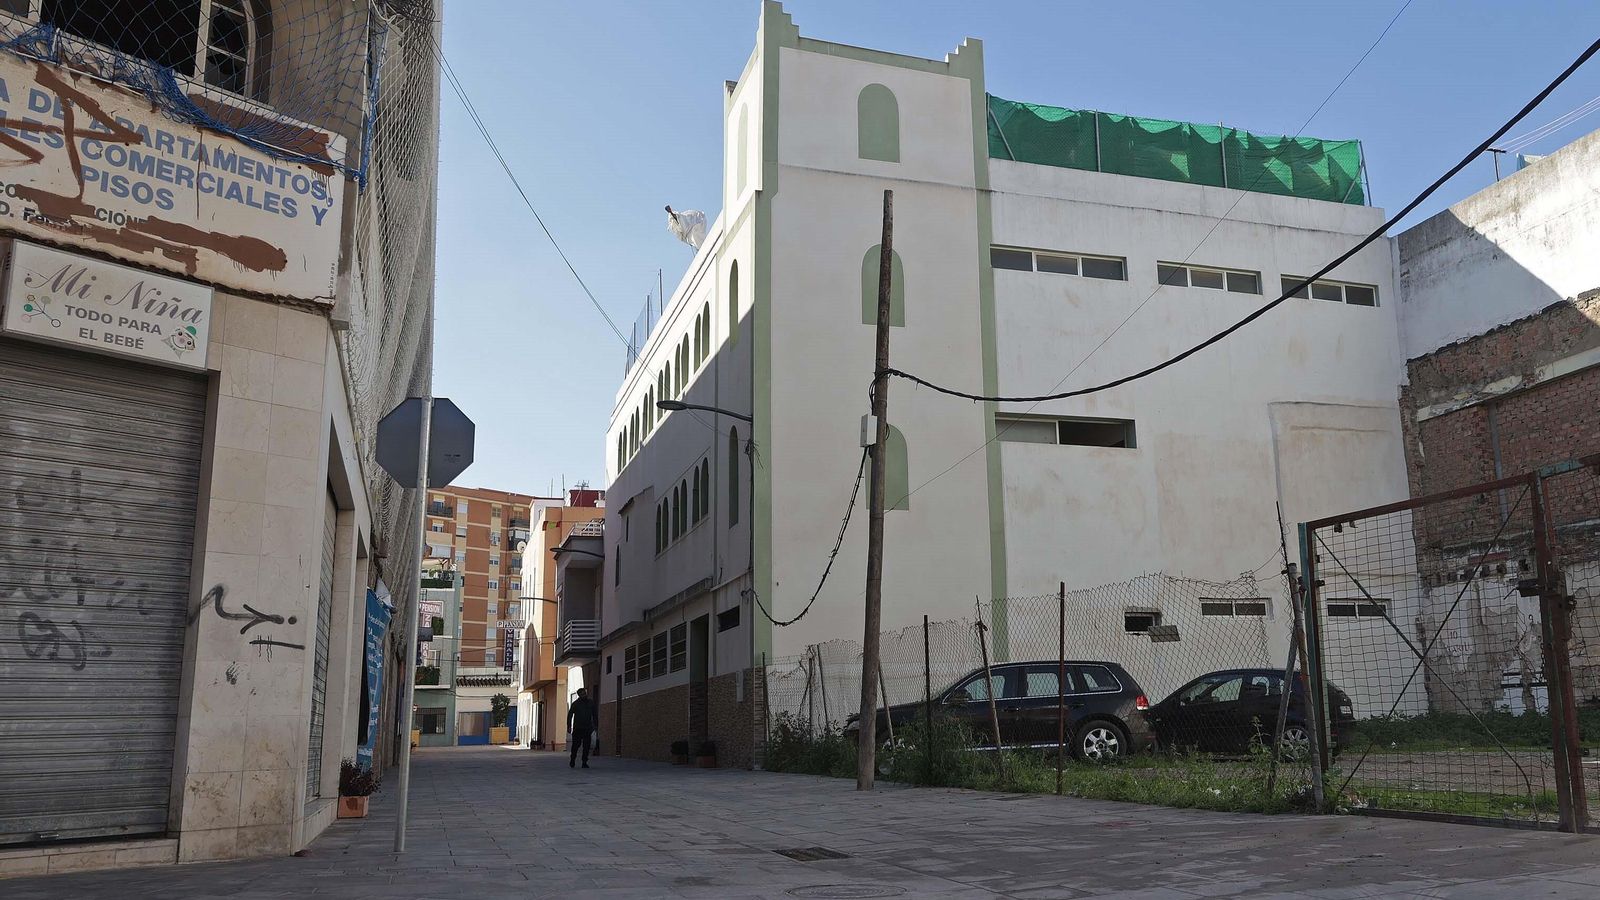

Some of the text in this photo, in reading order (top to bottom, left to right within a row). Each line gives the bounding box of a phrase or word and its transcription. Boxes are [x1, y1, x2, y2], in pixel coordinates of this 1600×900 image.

[80, 137, 298, 218] COMERCIALES
[311, 204, 329, 226] Y
[82, 164, 174, 211] PISOS
[24, 263, 204, 324] Mi Niña
[65, 304, 162, 336] TODO PARA
[78, 327, 145, 350] EL BEBÉ
